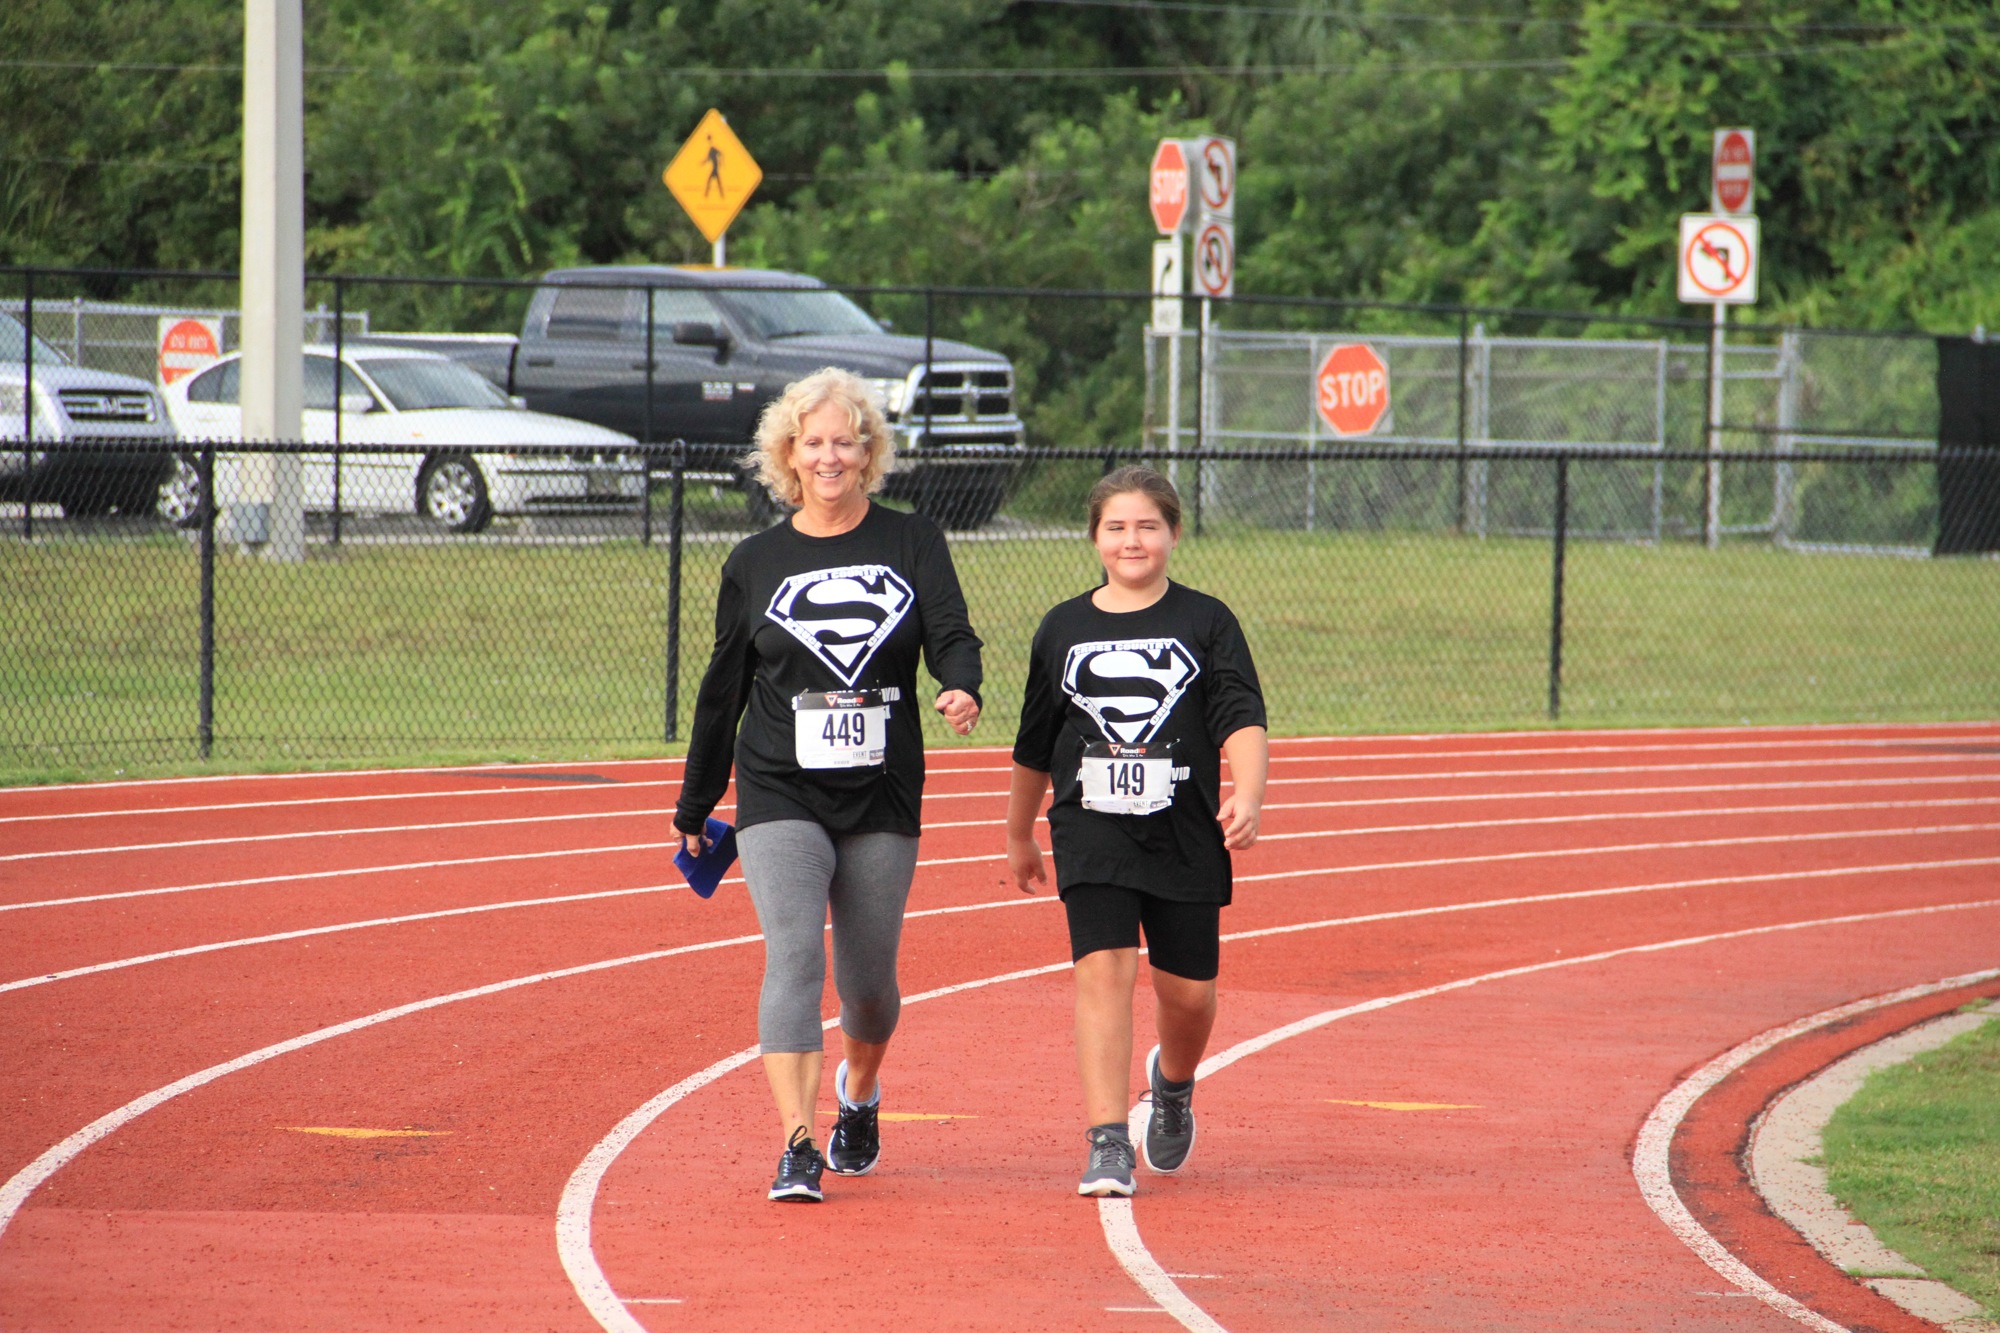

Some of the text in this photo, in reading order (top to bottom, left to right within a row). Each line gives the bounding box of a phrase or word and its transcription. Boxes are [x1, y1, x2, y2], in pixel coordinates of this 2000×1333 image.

[1153, 169, 1187, 204] STOP
[1321, 369, 1384, 410] STOP
[789, 567, 887, 587] CROSS COUNTRY
[784, 617, 823, 650] SPRUCE
[866, 609, 900, 648] CREEK
[1074, 641, 1173, 656] CROSS COUNTRY
[1148, 685, 1181, 726] CREEK
[822, 711, 865, 747] 449
[1107, 762, 1145, 796] 149
